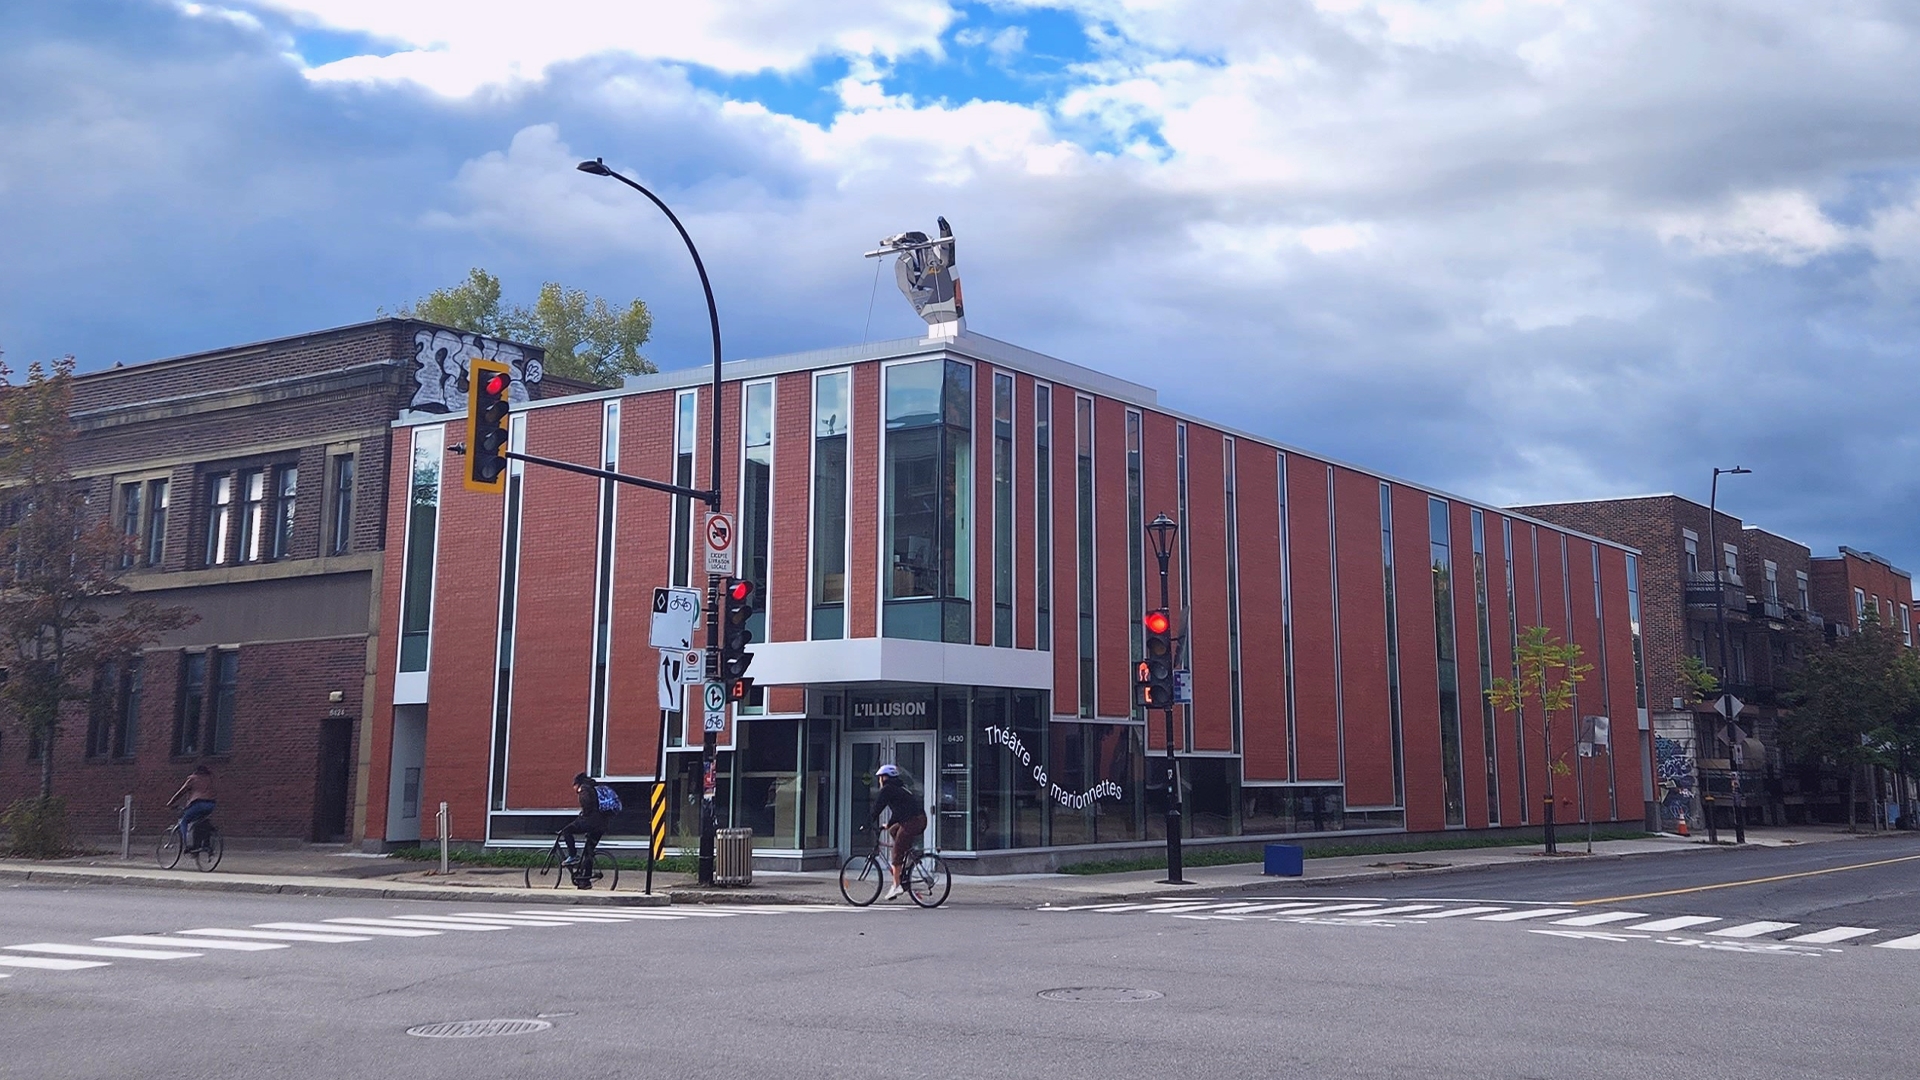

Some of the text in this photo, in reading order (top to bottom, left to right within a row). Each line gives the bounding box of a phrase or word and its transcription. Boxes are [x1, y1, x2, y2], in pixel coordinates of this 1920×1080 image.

[984, 724, 1122, 810] Théâtre de marionnettes
